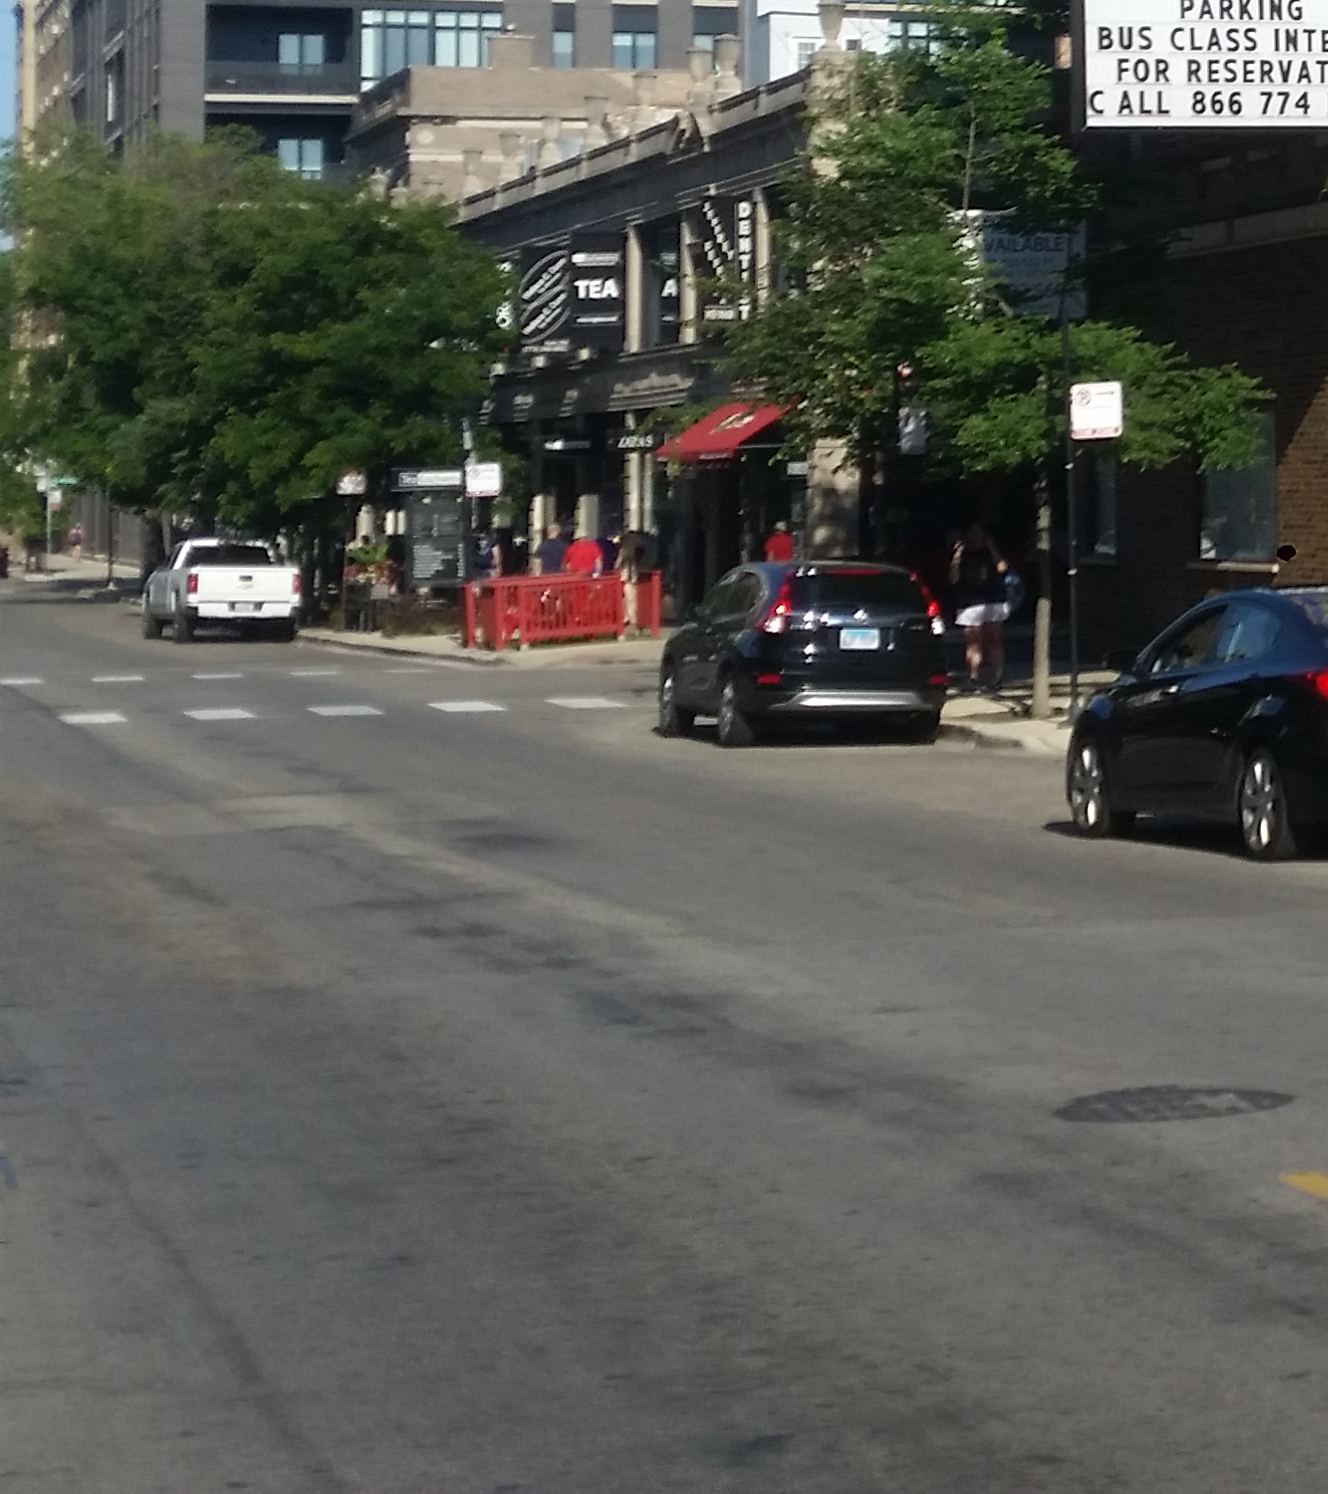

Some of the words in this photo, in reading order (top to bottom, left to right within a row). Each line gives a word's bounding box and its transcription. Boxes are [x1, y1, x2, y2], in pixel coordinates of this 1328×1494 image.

[1098, 26, 1152, 50] BUS
[1170, 27, 1257, 52] CLASS
[1116, 58, 1170, 83] FOR
[1192, 92, 1243, 115] 866
[1260, 91, 1311, 115] 774
[573, 277, 619, 299] TEA
